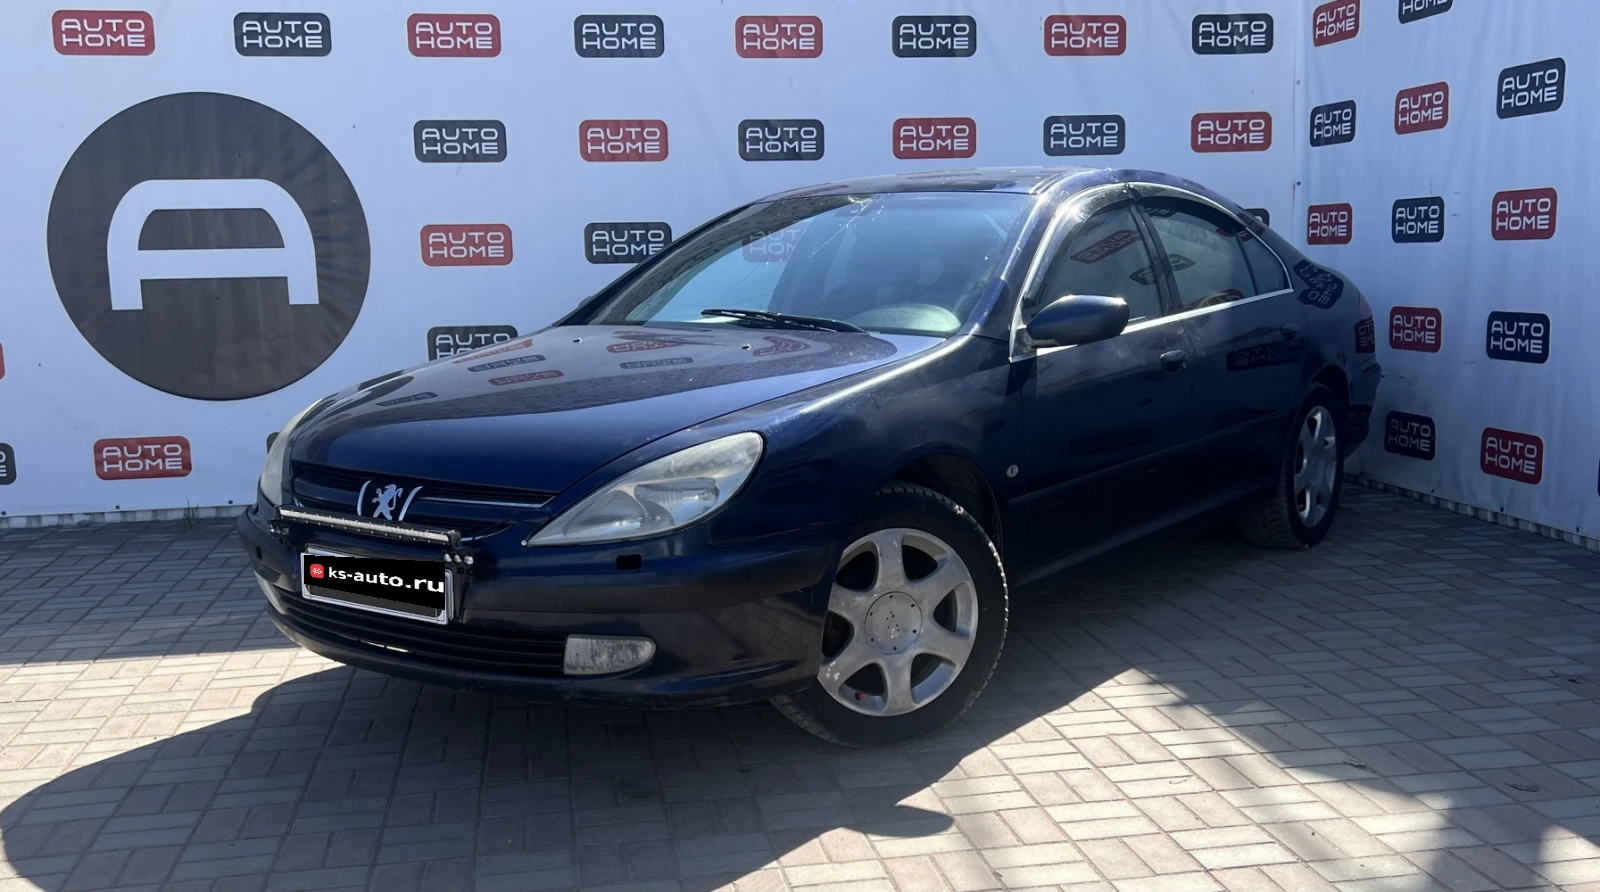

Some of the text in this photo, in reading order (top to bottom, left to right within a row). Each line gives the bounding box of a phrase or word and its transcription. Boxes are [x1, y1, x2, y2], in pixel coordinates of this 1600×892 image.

[1316, 3, 1356, 25] AUTO
[61, 18, 145, 32] AUTO
[242, 21, 322, 33] AUTO
[416, 22, 492, 35] AUTO
[582, 23, 656, 35] AUTO
[743, 24, 815, 36] AUTO
[899, 23, 969, 35] AUTO
[1051, 23, 1119, 35] AUTO
[1199, 21, 1267, 34] AUTO
[1315, 17, 1355, 39] HOME
[62, 34, 146, 47] HOME
[243, 35, 323, 48] HOME
[416, 36, 492, 49] HOME
[582, 37, 656, 49] HOME
[743, 38, 815, 50] HOME
[899, 37, 969, 49] HOME
[1051, 36, 1118, 48] HOME
[1199, 34, 1266, 47] HOME
[1502, 68, 1559, 92] AUTO
[1399, 91, 1444, 111] AUTO
[1501, 86, 1557, 109] HOME
[1314, 108, 1352, 126] AUTO
[1398, 106, 1443, 126] HOME
[900, 125, 969, 138] AUTO
[1050, 122, 1118, 135] AUTO
[1198, 119, 1265, 132] AUTO
[1313, 122, 1351, 139] HOME
[422, 128, 498, 140] AUTO
[587, 128, 660, 140] AUTO
[746, 127, 817, 139] AUTO
[1198, 132, 1264, 145] HOME
[422, 142, 498, 154] HOME
[587, 141, 660, 154] HOME
[746, 141, 816, 153] HOME
[900, 138, 968, 151] HOME
[1050, 136, 1118, 148] HOME
[1396, 205, 1440, 220] AUTO
[1497, 198, 1551, 214] AUTO
[1309, 211, 1348, 224] AUTO
[1496, 215, 1549, 231] HOME
[1309, 225, 1347, 237] HOME
[1395, 220, 1439, 234] HOME
[429, 232, 504, 244] AUTO
[592, 230, 665, 242] AUTO
[429, 245, 504, 258] HOME
[592, 243, 664, 256] HOME
[1393, 315, 1436, 329] AUTO
[1491, 320, 1544, 337] AUTO
[435, 333, 511, 346] AUTO
[1393, 329, 1435, 344] HOME
[1490, 336, 1543, 354] HOME
[1390, 418, 1431, 438] AUTO
[1388, 434, 1430, 452] HOME
[1486, 437, 1537, 458] AUTO
[102, 444, 182, 459] AUTO
[103, 457, 182, 472] HOME
[1485, 452, 1535, 475] HOME
